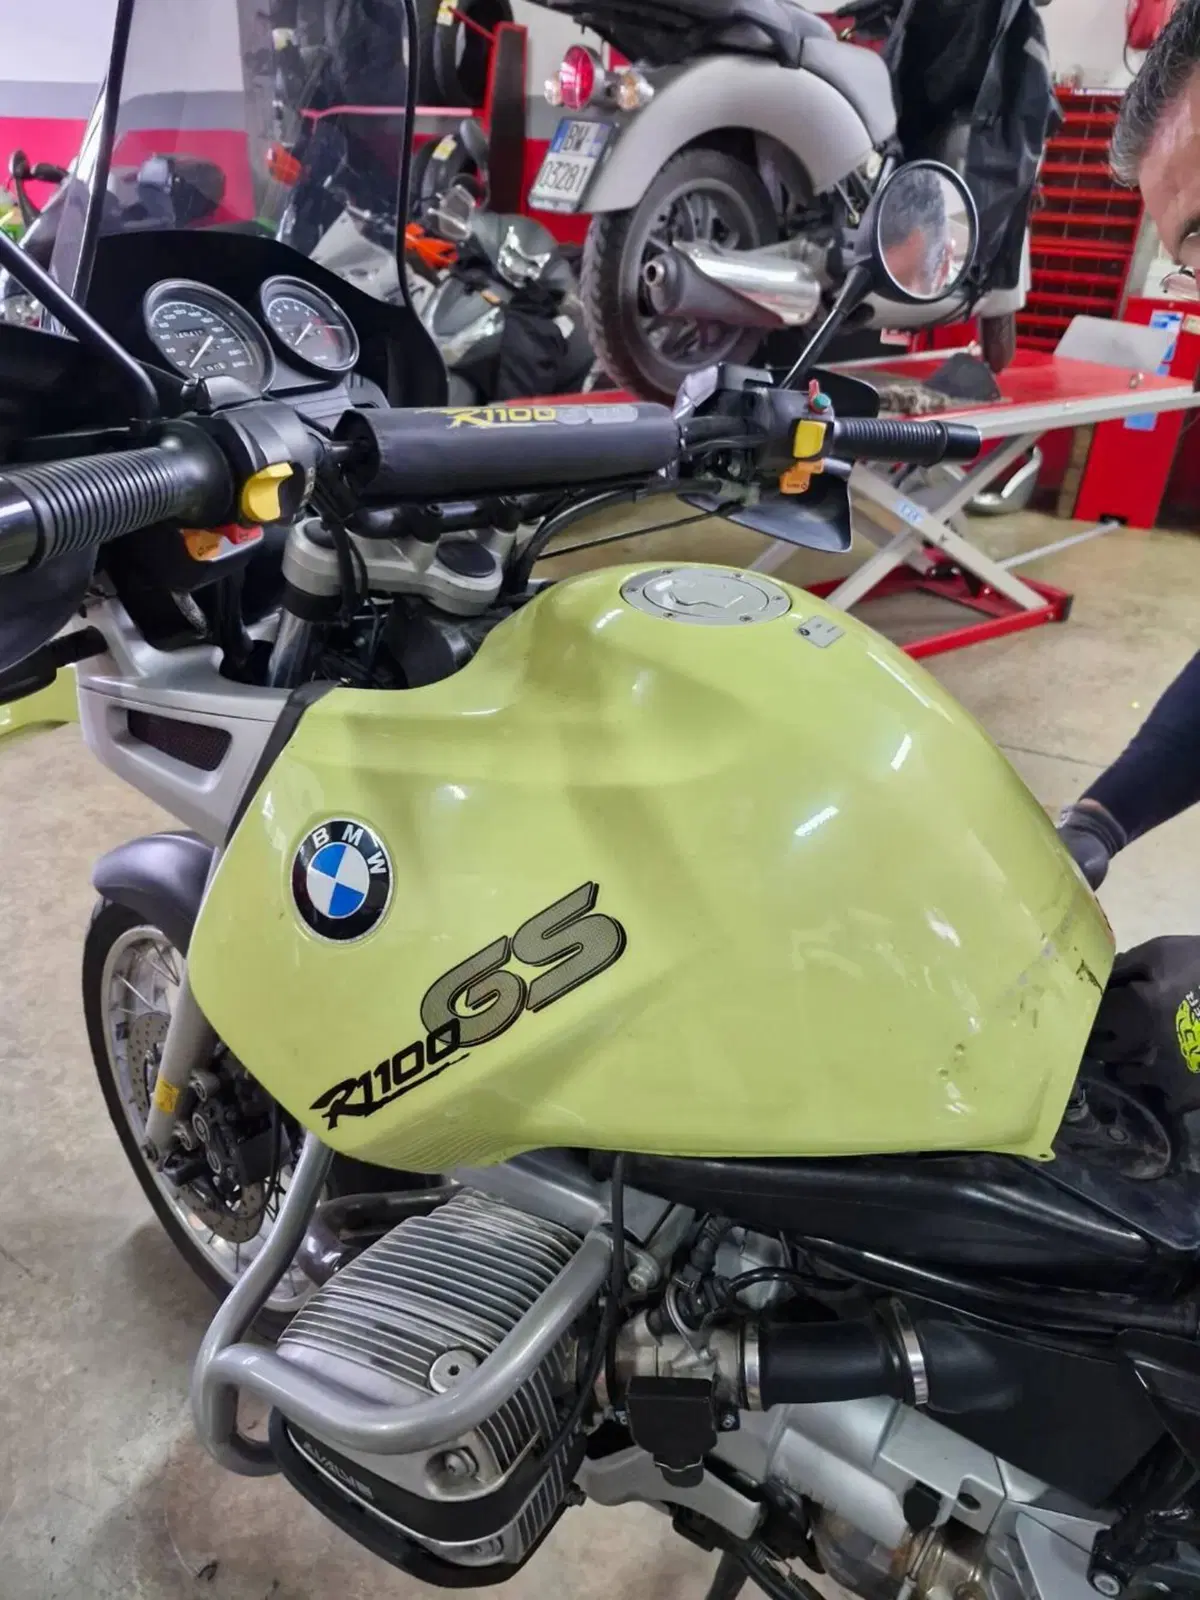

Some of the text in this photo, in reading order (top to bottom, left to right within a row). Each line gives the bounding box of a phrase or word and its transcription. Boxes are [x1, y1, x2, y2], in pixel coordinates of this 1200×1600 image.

[425, 406, 557, 428] R1100
[311, 824, 387, 875] BMW
[420, 881, 627, 1048] GS
[309, 1017, 470, 1131] R1100
